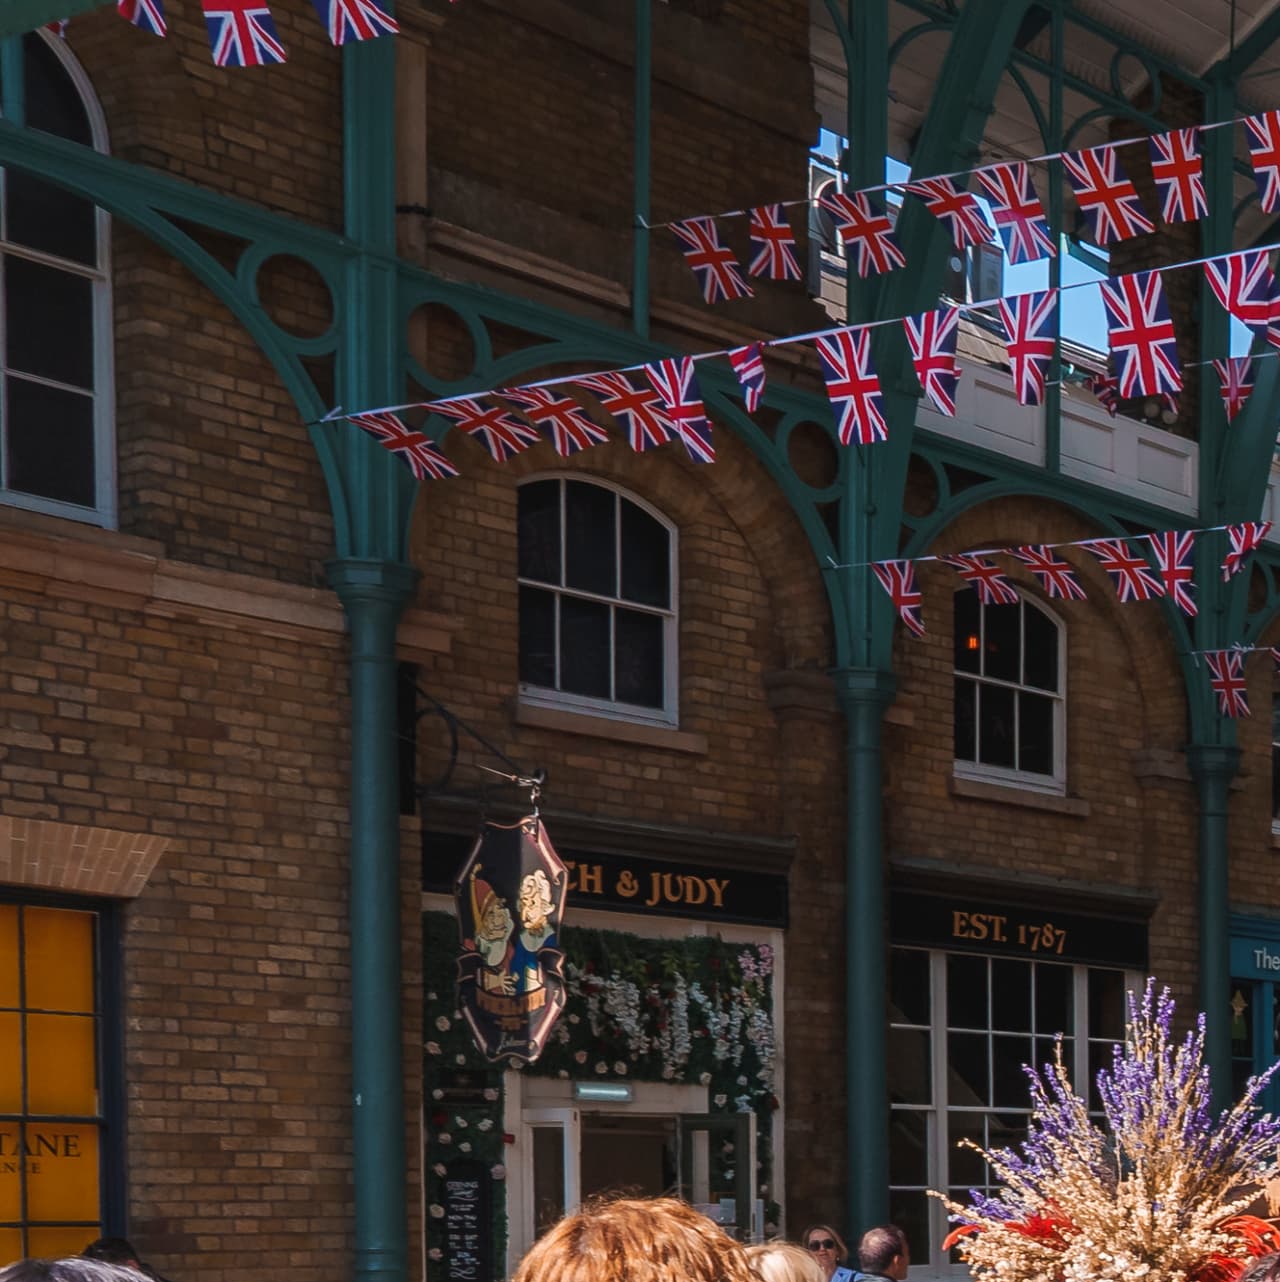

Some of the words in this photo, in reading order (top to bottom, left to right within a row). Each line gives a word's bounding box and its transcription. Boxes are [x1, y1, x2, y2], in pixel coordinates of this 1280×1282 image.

[616, 870, 639, 898] &
[645, 872, 730, 907] JUDY
[952, 910, 1008, 942] EST.
[1018, 923, 1067, 954] 1787
[1254, 948, 1280, 970] The
